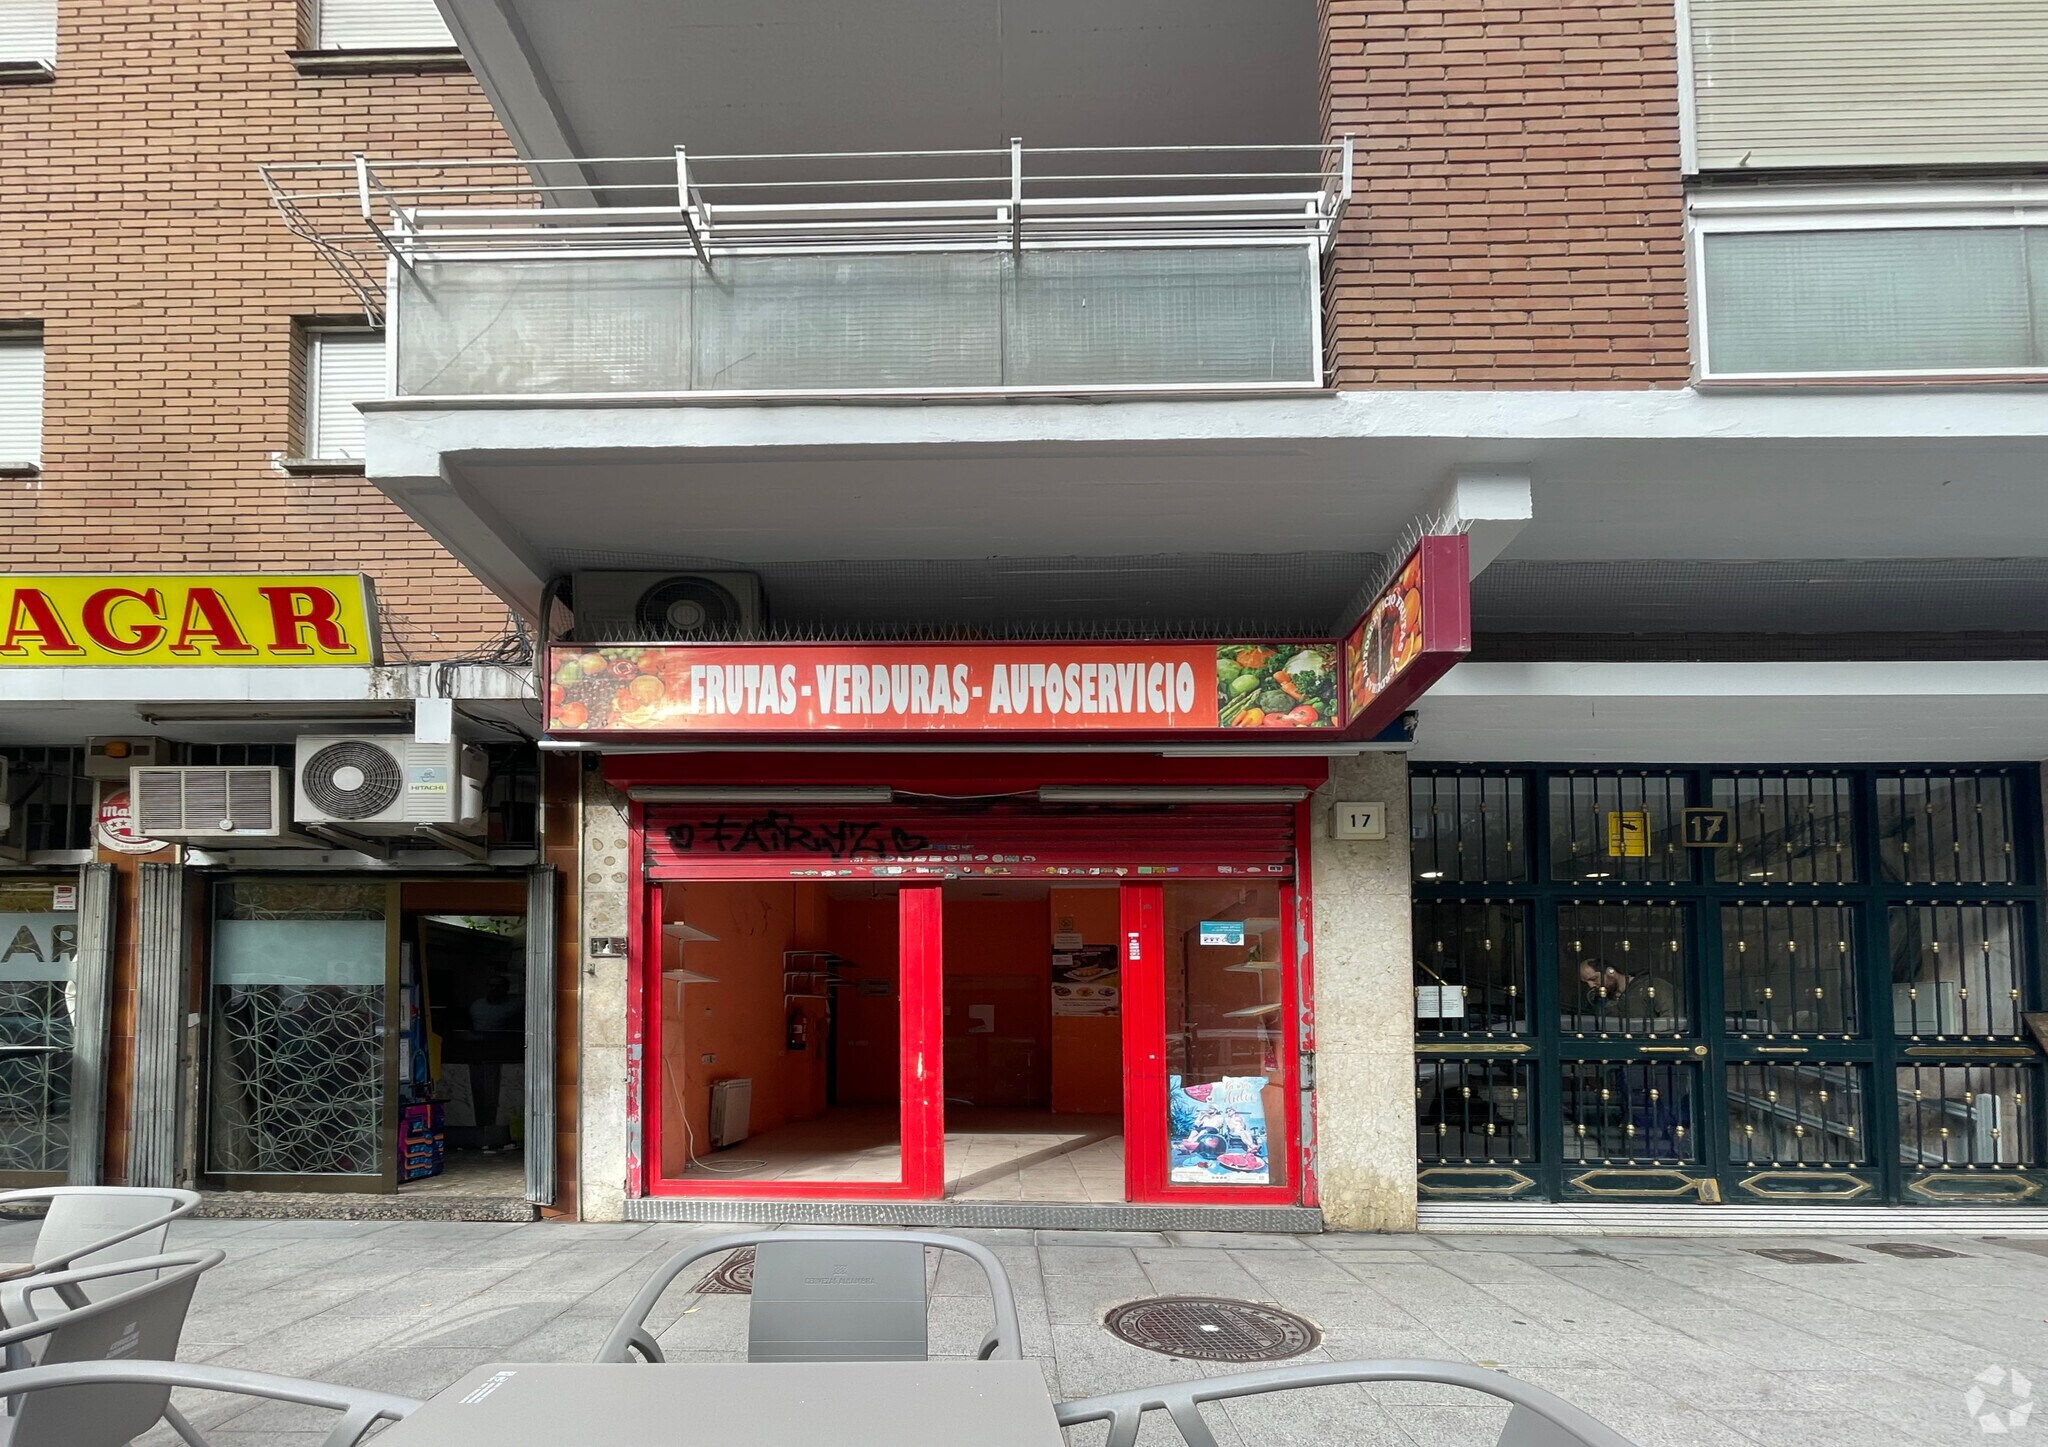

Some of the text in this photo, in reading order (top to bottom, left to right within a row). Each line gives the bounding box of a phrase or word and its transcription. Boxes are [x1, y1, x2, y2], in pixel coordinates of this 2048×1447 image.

[0, 586, 356, 655] AGAR
[1394, 593, 1407, 652] FRUTAS
[690, 664, 797, 715] FRUTAS
[815, 664, 969, 715] VERDURAS
[988, 661, 1195, 715] AUTOSERVICIO
[1351, 814, 1371, 827] 17
[1691, 815, 1723, 841] 17
